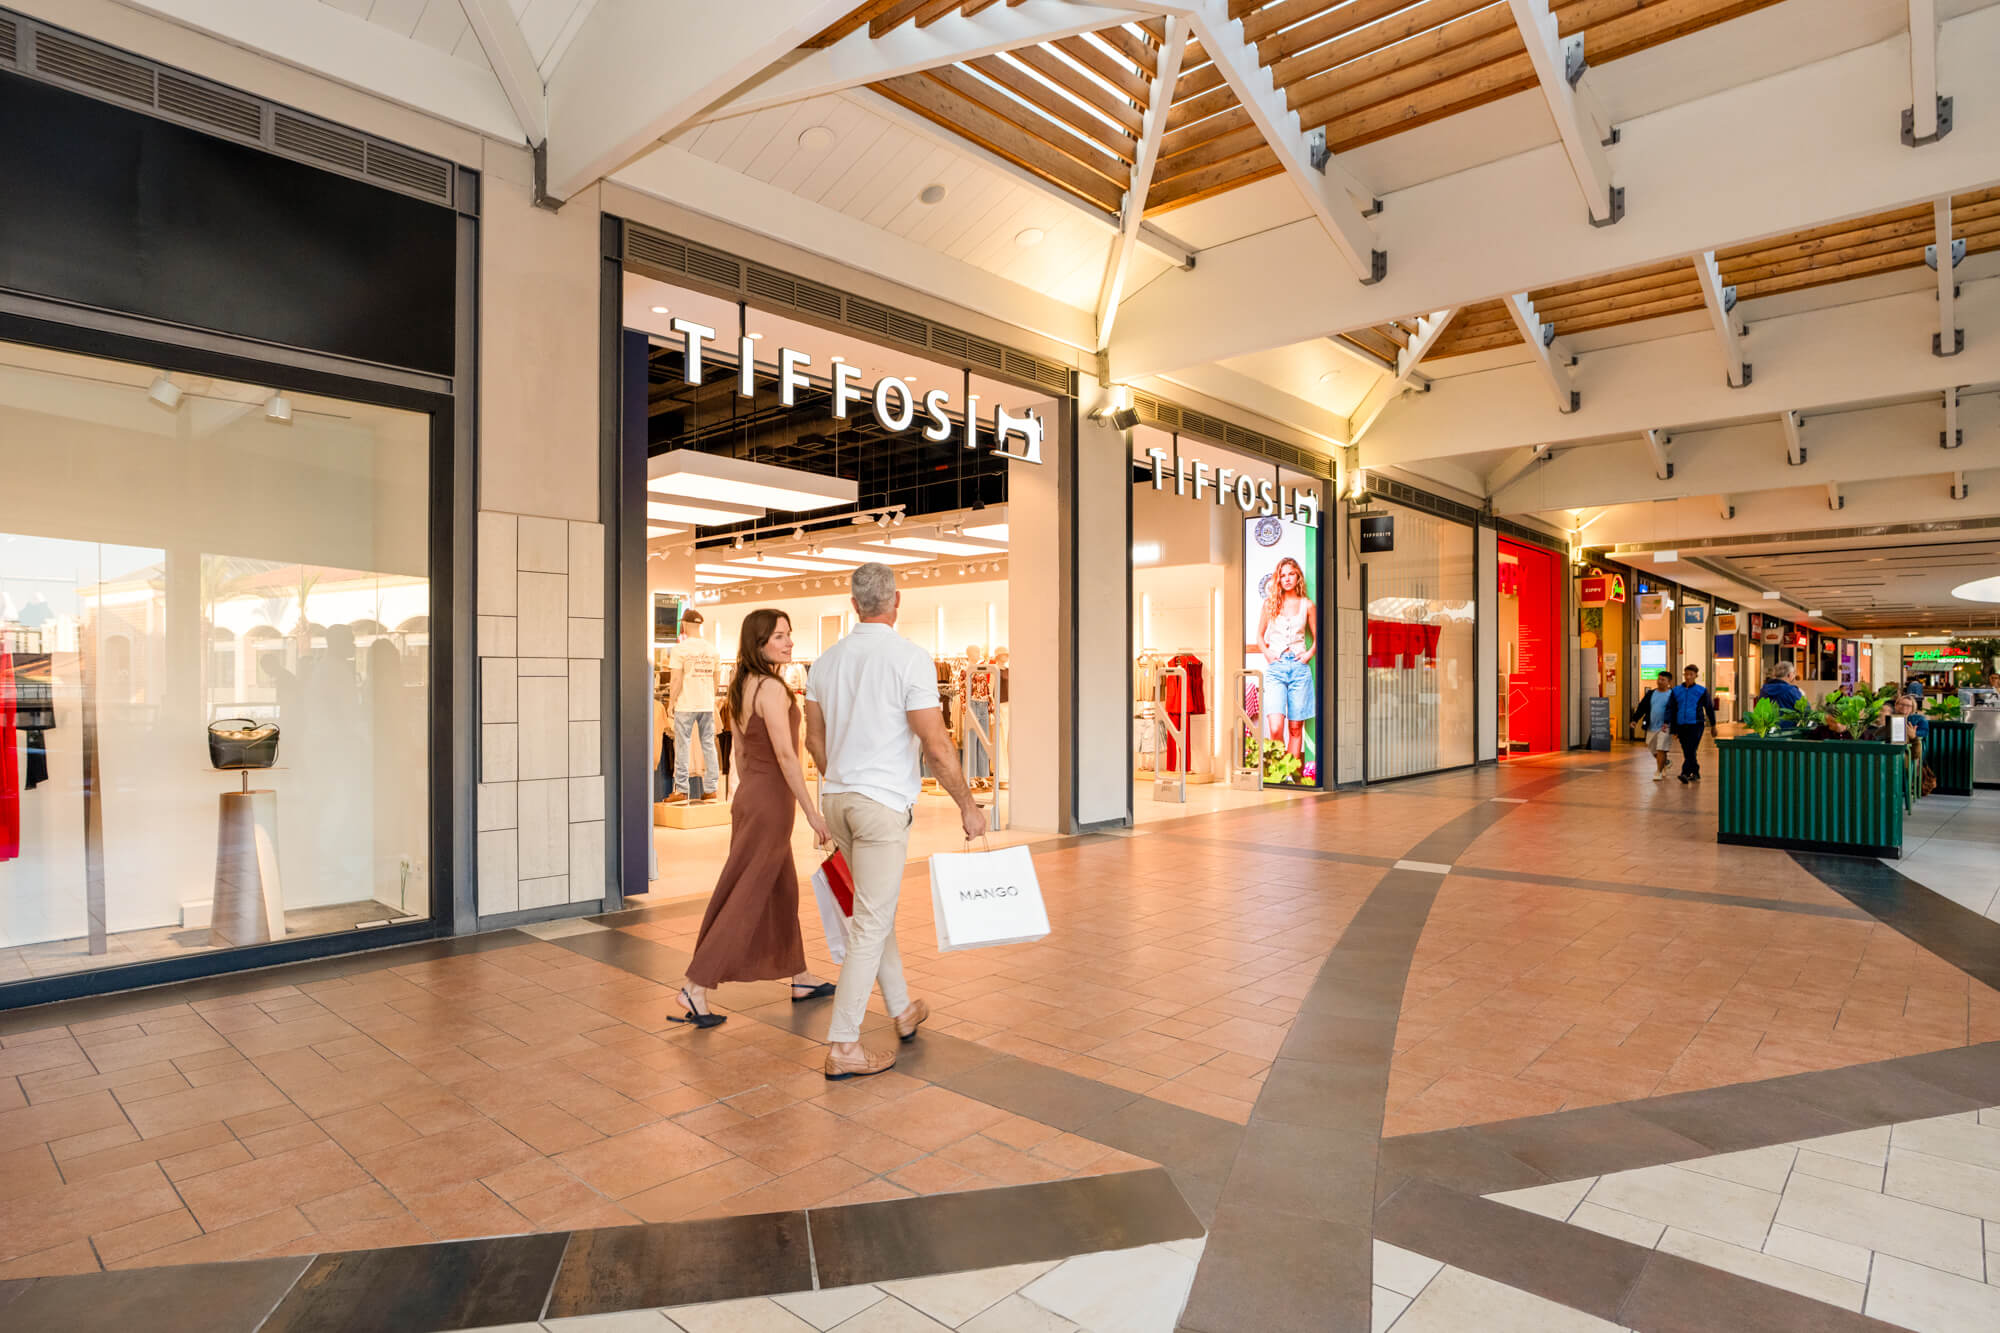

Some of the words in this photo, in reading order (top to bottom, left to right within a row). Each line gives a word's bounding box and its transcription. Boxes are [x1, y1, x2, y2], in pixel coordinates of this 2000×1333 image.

[670, 316, 978, 449] TIFFOSI
[1146, 447, 1286, 520] TIFFOSI
[959, 886, 1018, 901] MANGO
